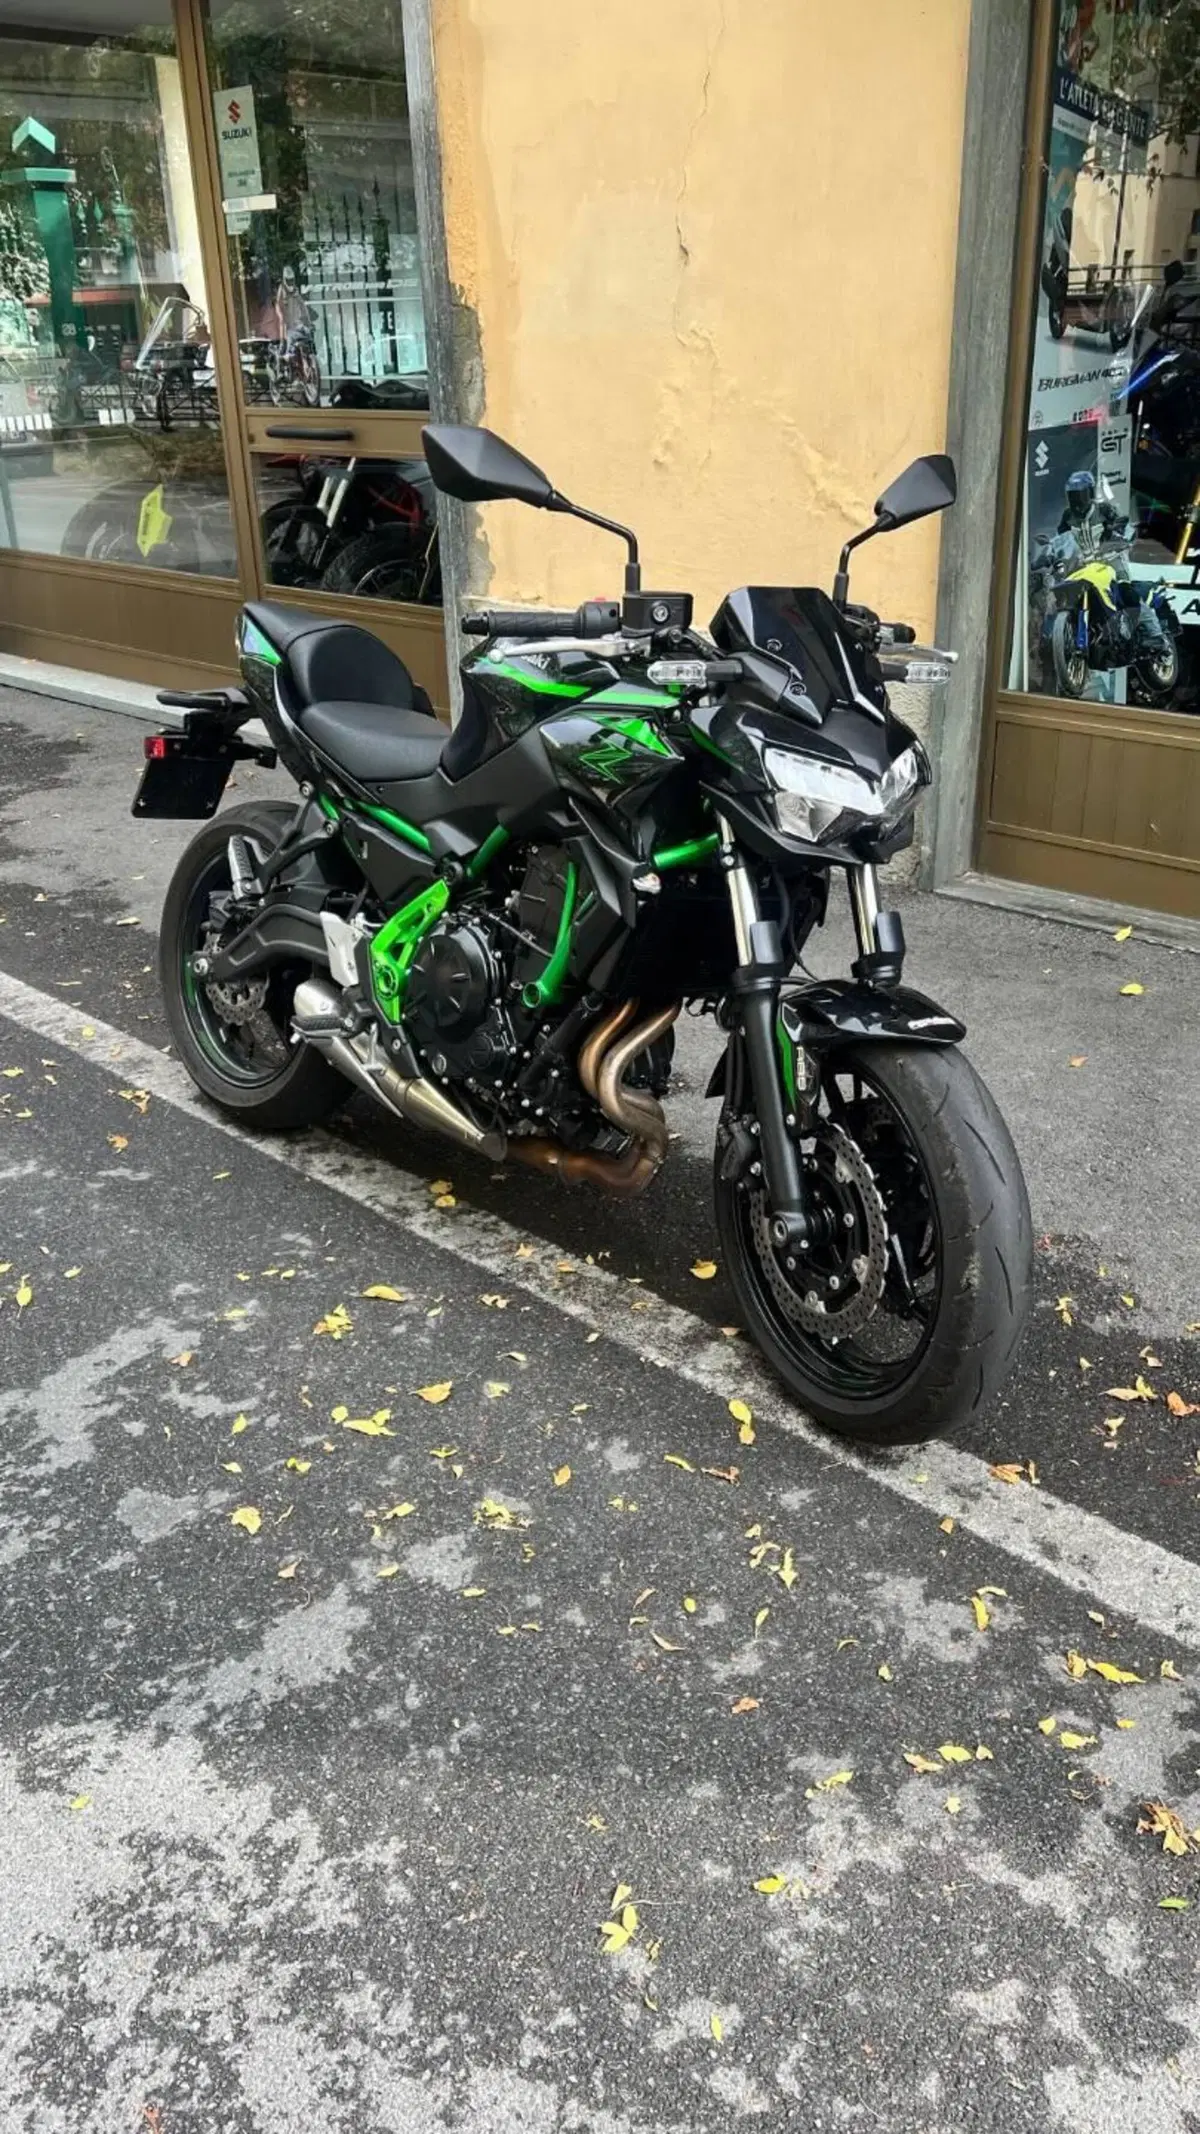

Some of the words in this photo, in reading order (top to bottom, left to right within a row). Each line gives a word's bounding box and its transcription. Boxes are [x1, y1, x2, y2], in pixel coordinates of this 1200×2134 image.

[1060, 77, 1099, 117] L'ATLETA
[221, 127, 252, 140] SUZUKI
[1038, 368, 1101, 392] BURGMAN
[796, 1046, 807, 1091] ABS
